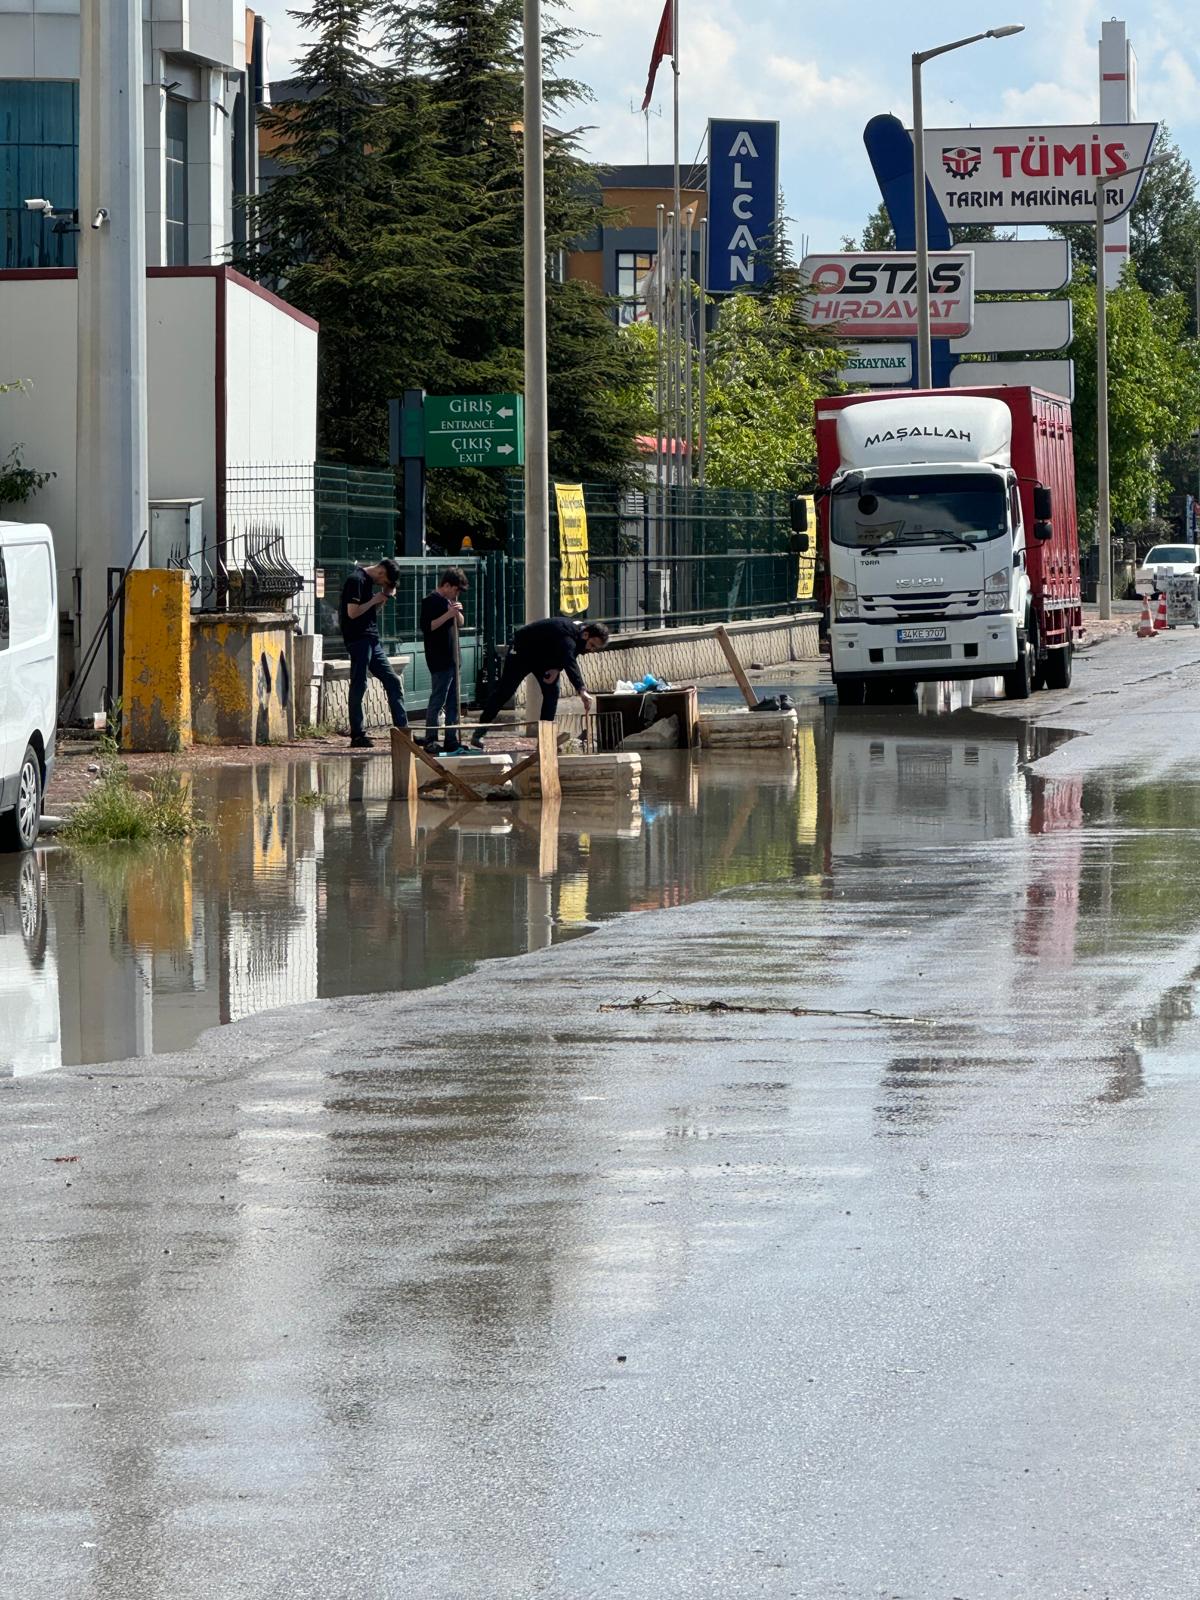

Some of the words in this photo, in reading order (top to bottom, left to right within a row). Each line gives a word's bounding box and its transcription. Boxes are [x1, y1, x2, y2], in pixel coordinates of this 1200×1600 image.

[728, 131, 759, 282] ALCAN
[946, 191, 1004, 208] TARIM
[811, 300, 960, 319] HIRDAVAT
[449, 398, 492, 415] GİRİŞ
[441, 419, 495, 430] ENTRANCE
[451, 437, 492, 453] ÇIKIŞ
[864, 426, 971, 448] MAŞALLAH
[459, 453, 485, 463] EXIT
[896, 577, 944, 589] ISUZU
